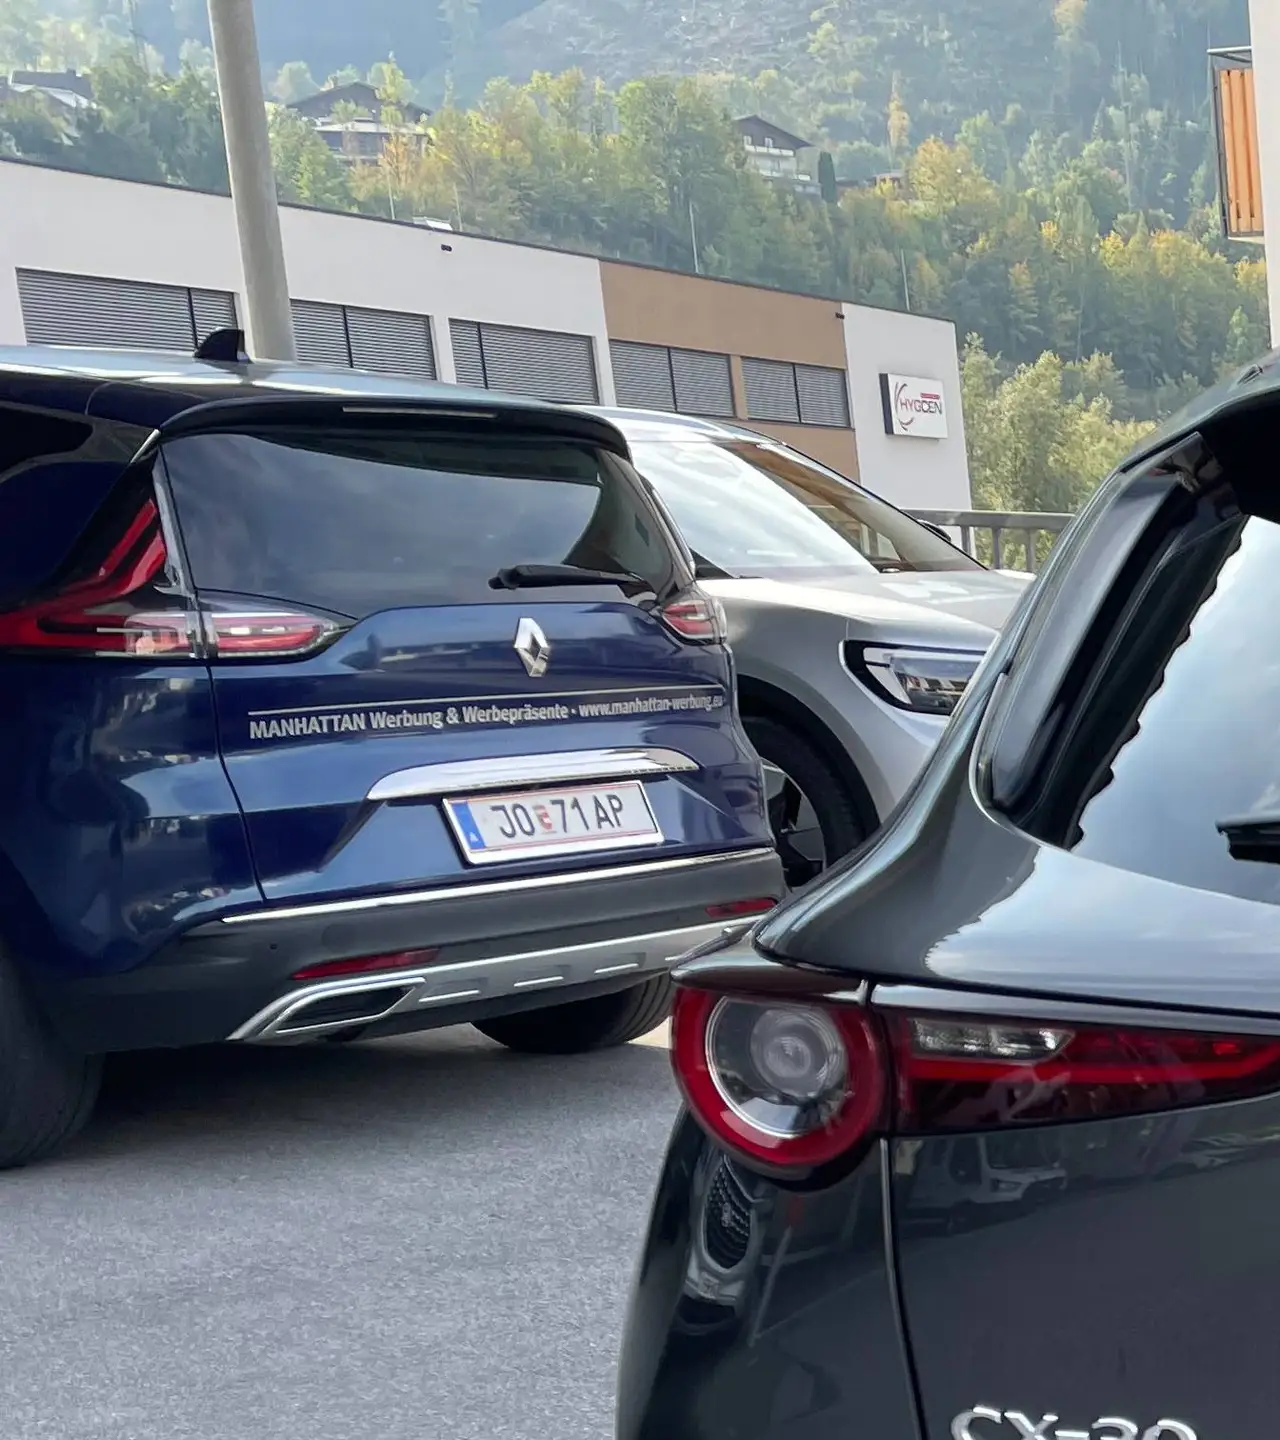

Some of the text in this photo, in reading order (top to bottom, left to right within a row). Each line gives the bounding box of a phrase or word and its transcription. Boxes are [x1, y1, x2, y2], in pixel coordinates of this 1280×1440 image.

[249, 694, 723, 739] MANHATTAN Werbung & Werbepräsente www.manhattan-werbung.eu
[490, 803, 536, 839] JO
